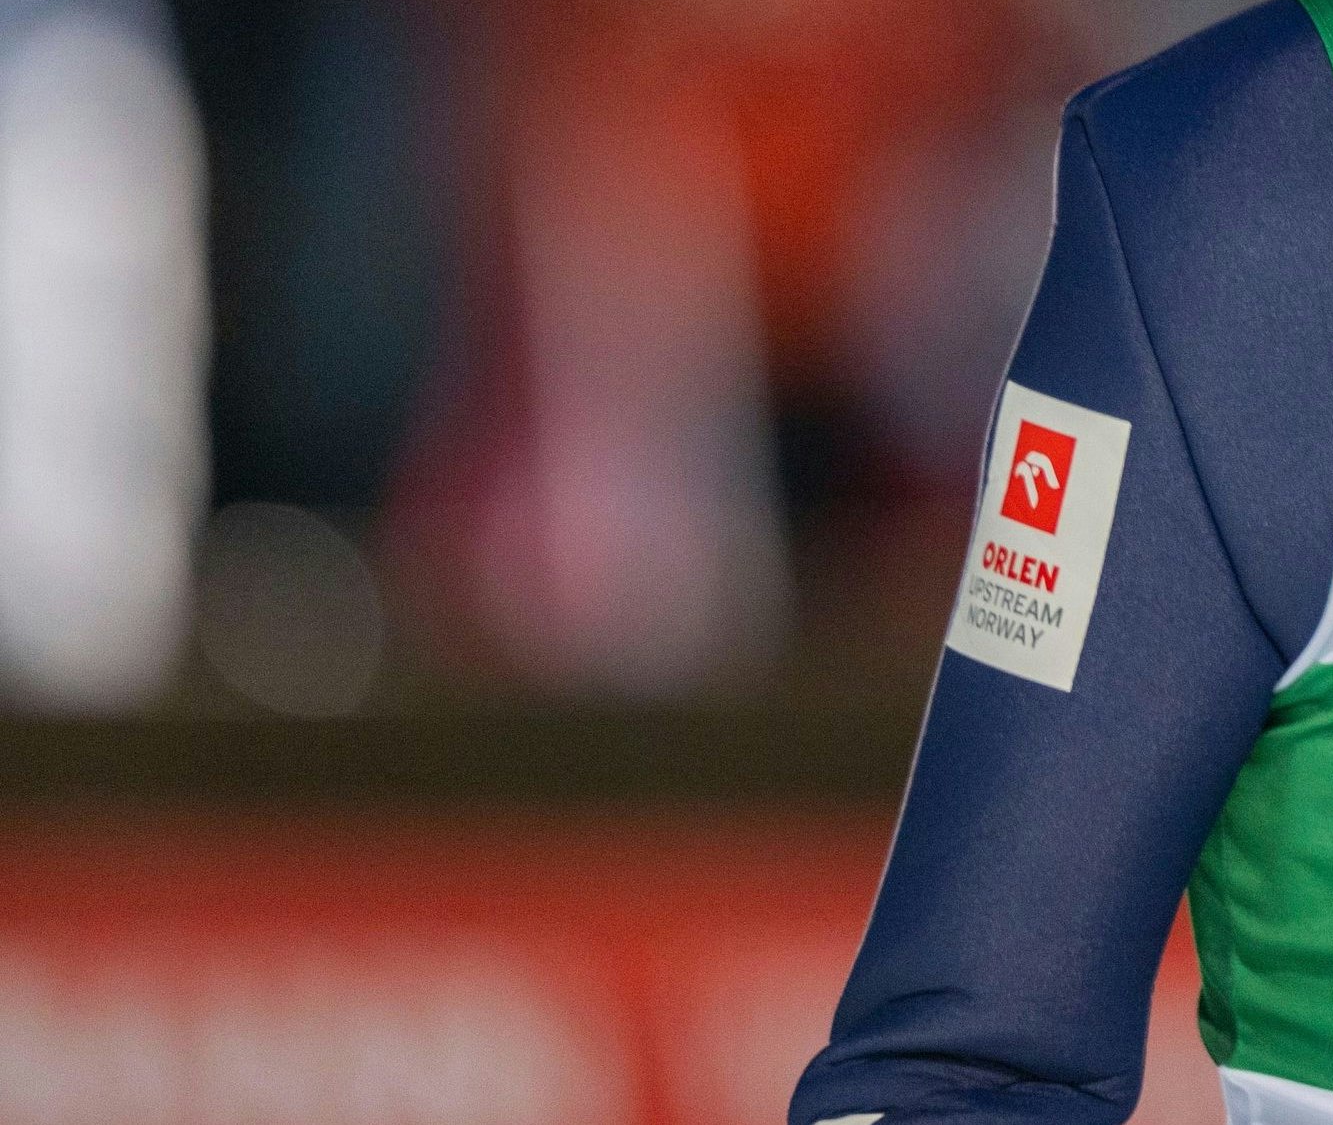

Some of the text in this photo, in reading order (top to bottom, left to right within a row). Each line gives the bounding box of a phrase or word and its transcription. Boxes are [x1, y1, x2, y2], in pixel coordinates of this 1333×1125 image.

[983, 541, 1060, 594] ORLEN
[966, 603, 1044, 649] NORWAY
[968, 573, 1064, 628] UPSTREAM
